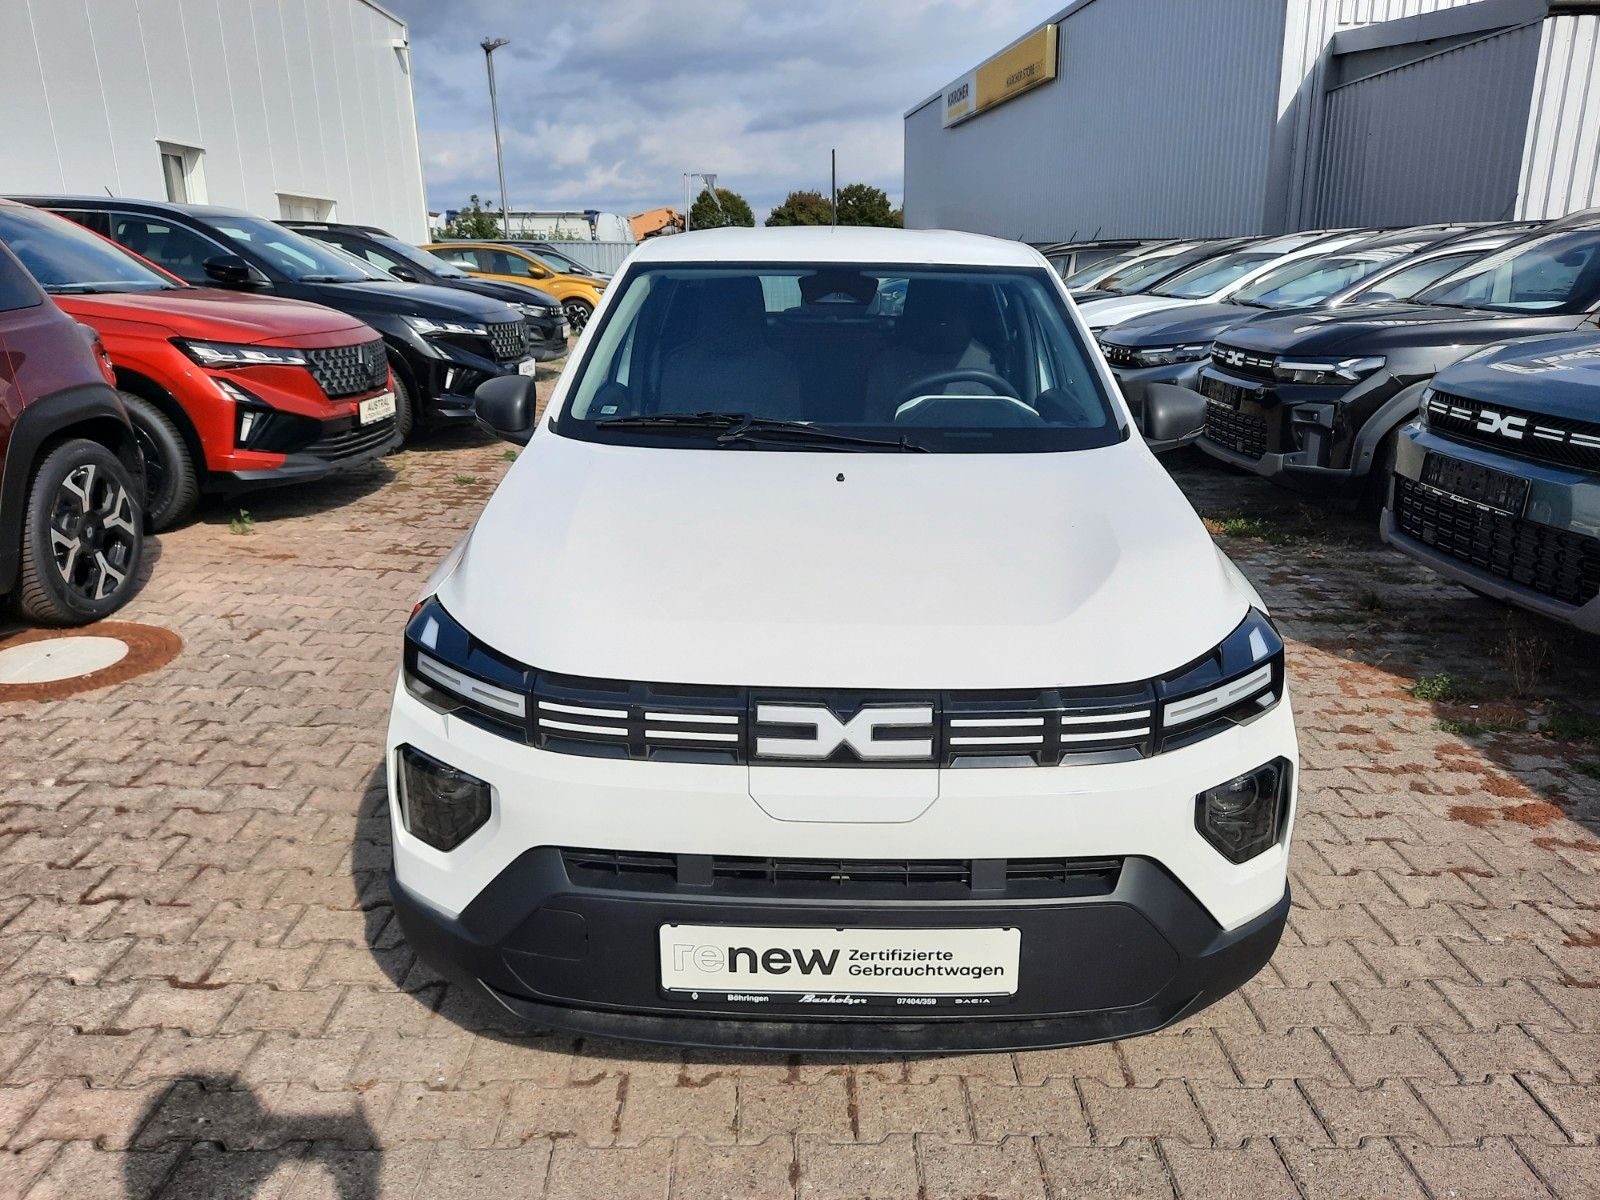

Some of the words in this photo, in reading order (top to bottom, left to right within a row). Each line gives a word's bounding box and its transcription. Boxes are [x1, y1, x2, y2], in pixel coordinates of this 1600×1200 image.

[673, 943, 840, 975] renew
[848, 949, 954, 961] Zertifizierte
[848, 964, 1005, 979] Gebrauchtwagen
[727, 993, 769, 1003] Böhringen
